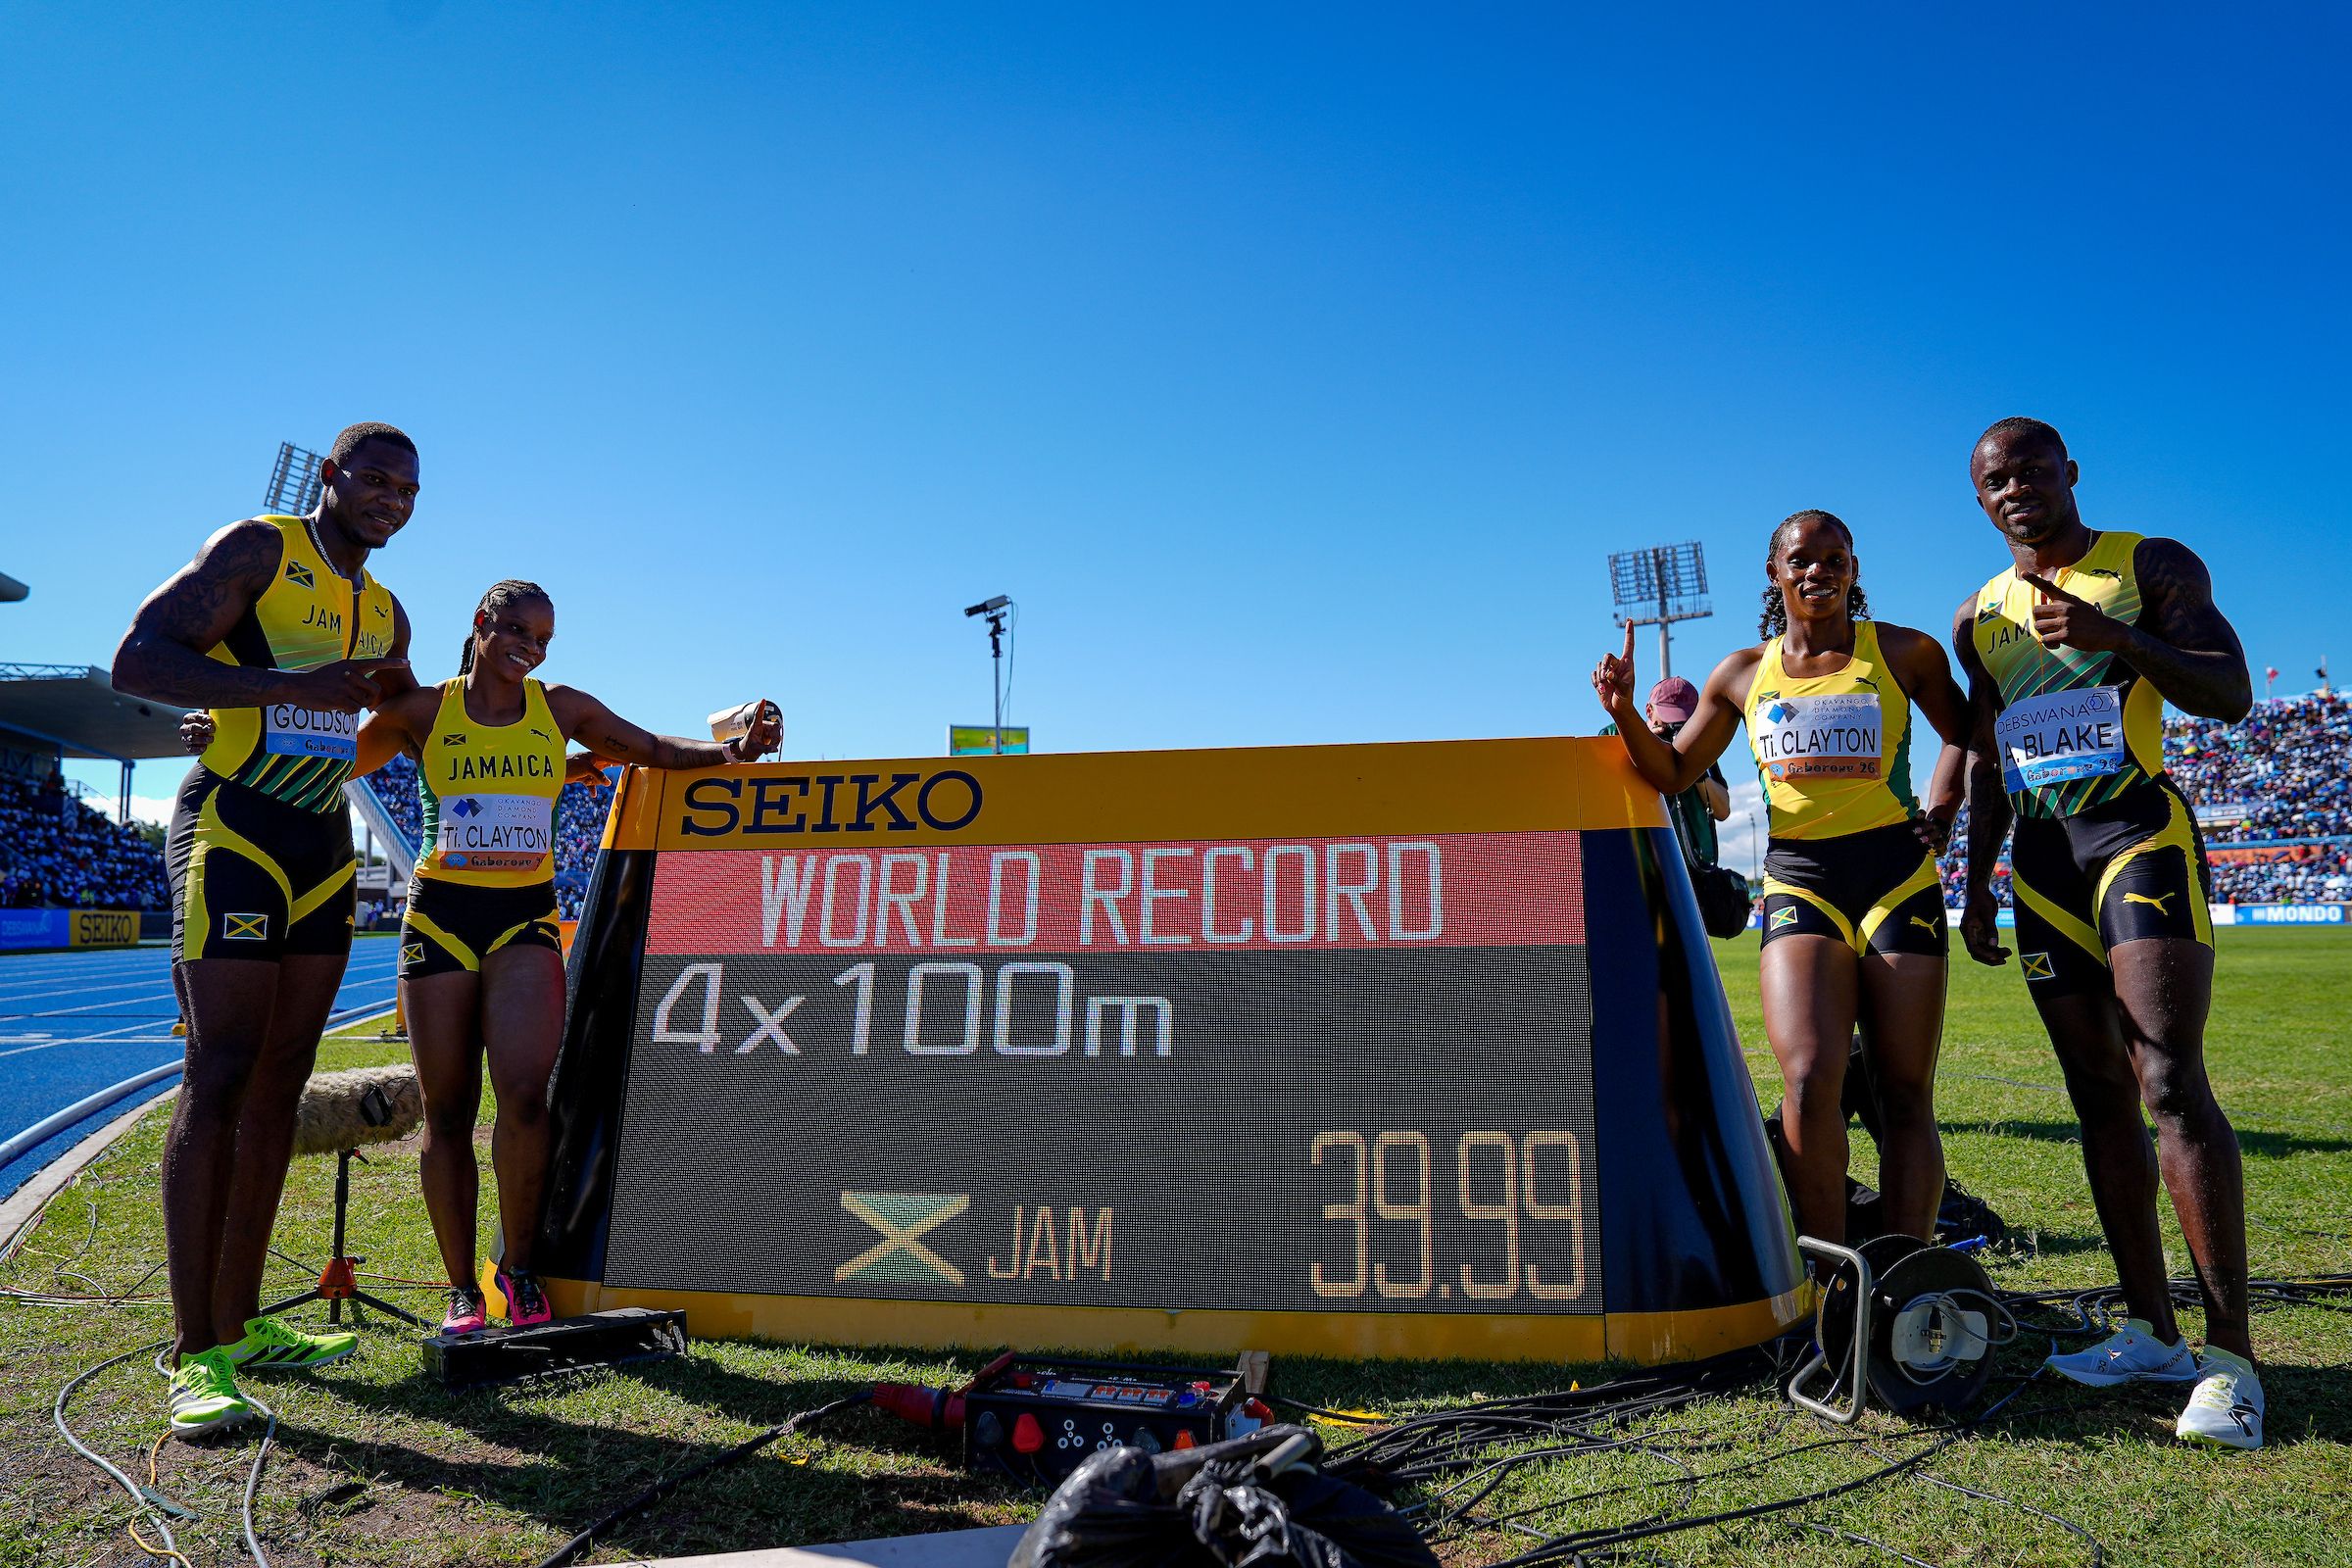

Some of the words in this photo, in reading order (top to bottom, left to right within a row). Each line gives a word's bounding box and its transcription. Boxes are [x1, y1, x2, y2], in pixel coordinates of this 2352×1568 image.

[1996, 704, 2090, 735] DEBSWANA
[1759, 734, 1778, 760] Ti.
[1782, 727, 1876, 755] CLAYTON
[2005, 740, 2020, 767] A.
[2023, 722, 2114, 760] BLAKE
[448, 755, 554, 781] JAMAICA
[1860, 762, 1876, 773] 26
[497, 798, 541, 807] OKAVANGO
[681, 769, 983, 837] SEIKO
[444, 826, 461, 849] Ti.
[466, 825, 547, 850] CLAYTON
[761, 851, 1040, 949] WORLD
[1080, 842, 1443, 946] RECORD
[79, 913, 132, 944] SEIKO
[2266, 906, 2341, 922] MONDO
[989, 1204, 1113, 1281] JAM
[1310, 1131, 1585, 1299] 39.99
